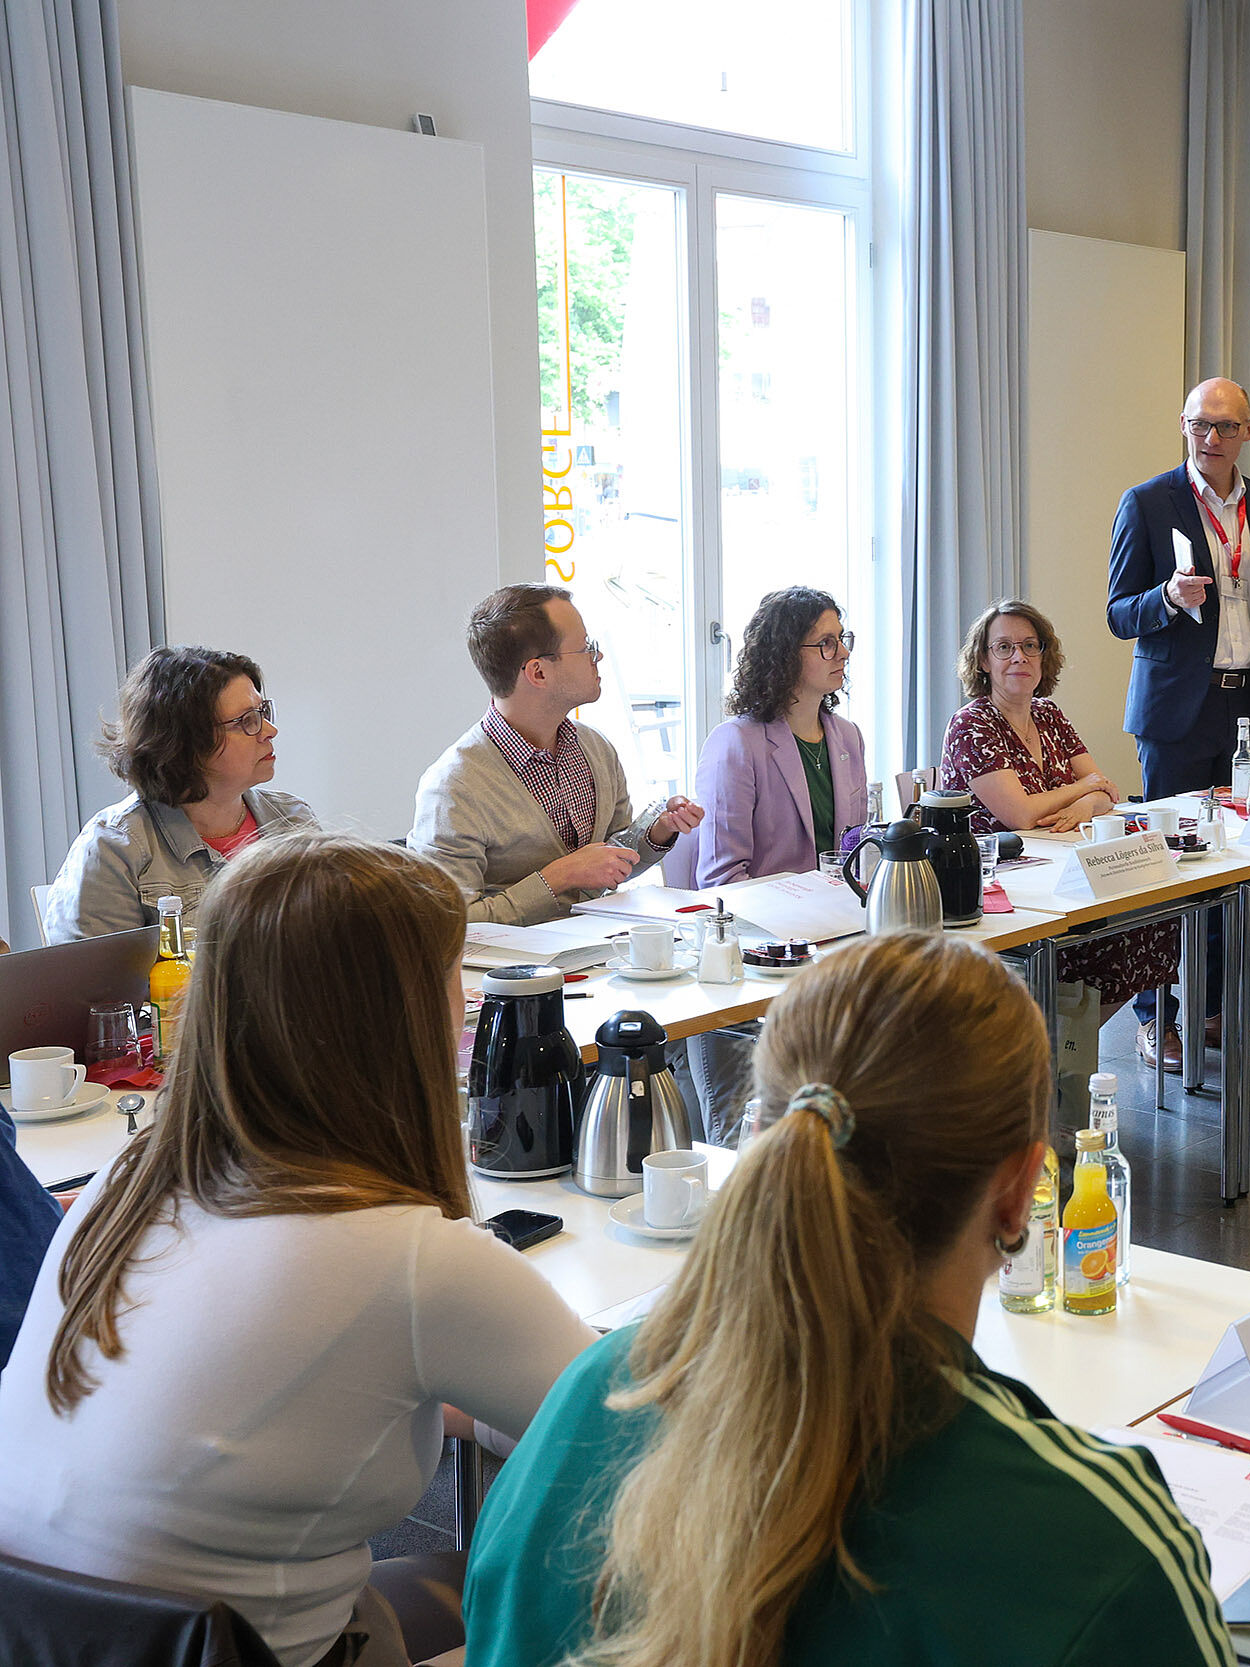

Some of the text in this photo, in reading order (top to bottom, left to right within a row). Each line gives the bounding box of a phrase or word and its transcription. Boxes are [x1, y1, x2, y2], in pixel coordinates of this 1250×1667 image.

[1086, 855, 1115, 867] Rebecca
[1139, 845, 1148, 855] da
[1148, 842, 1165, 853] Silva
